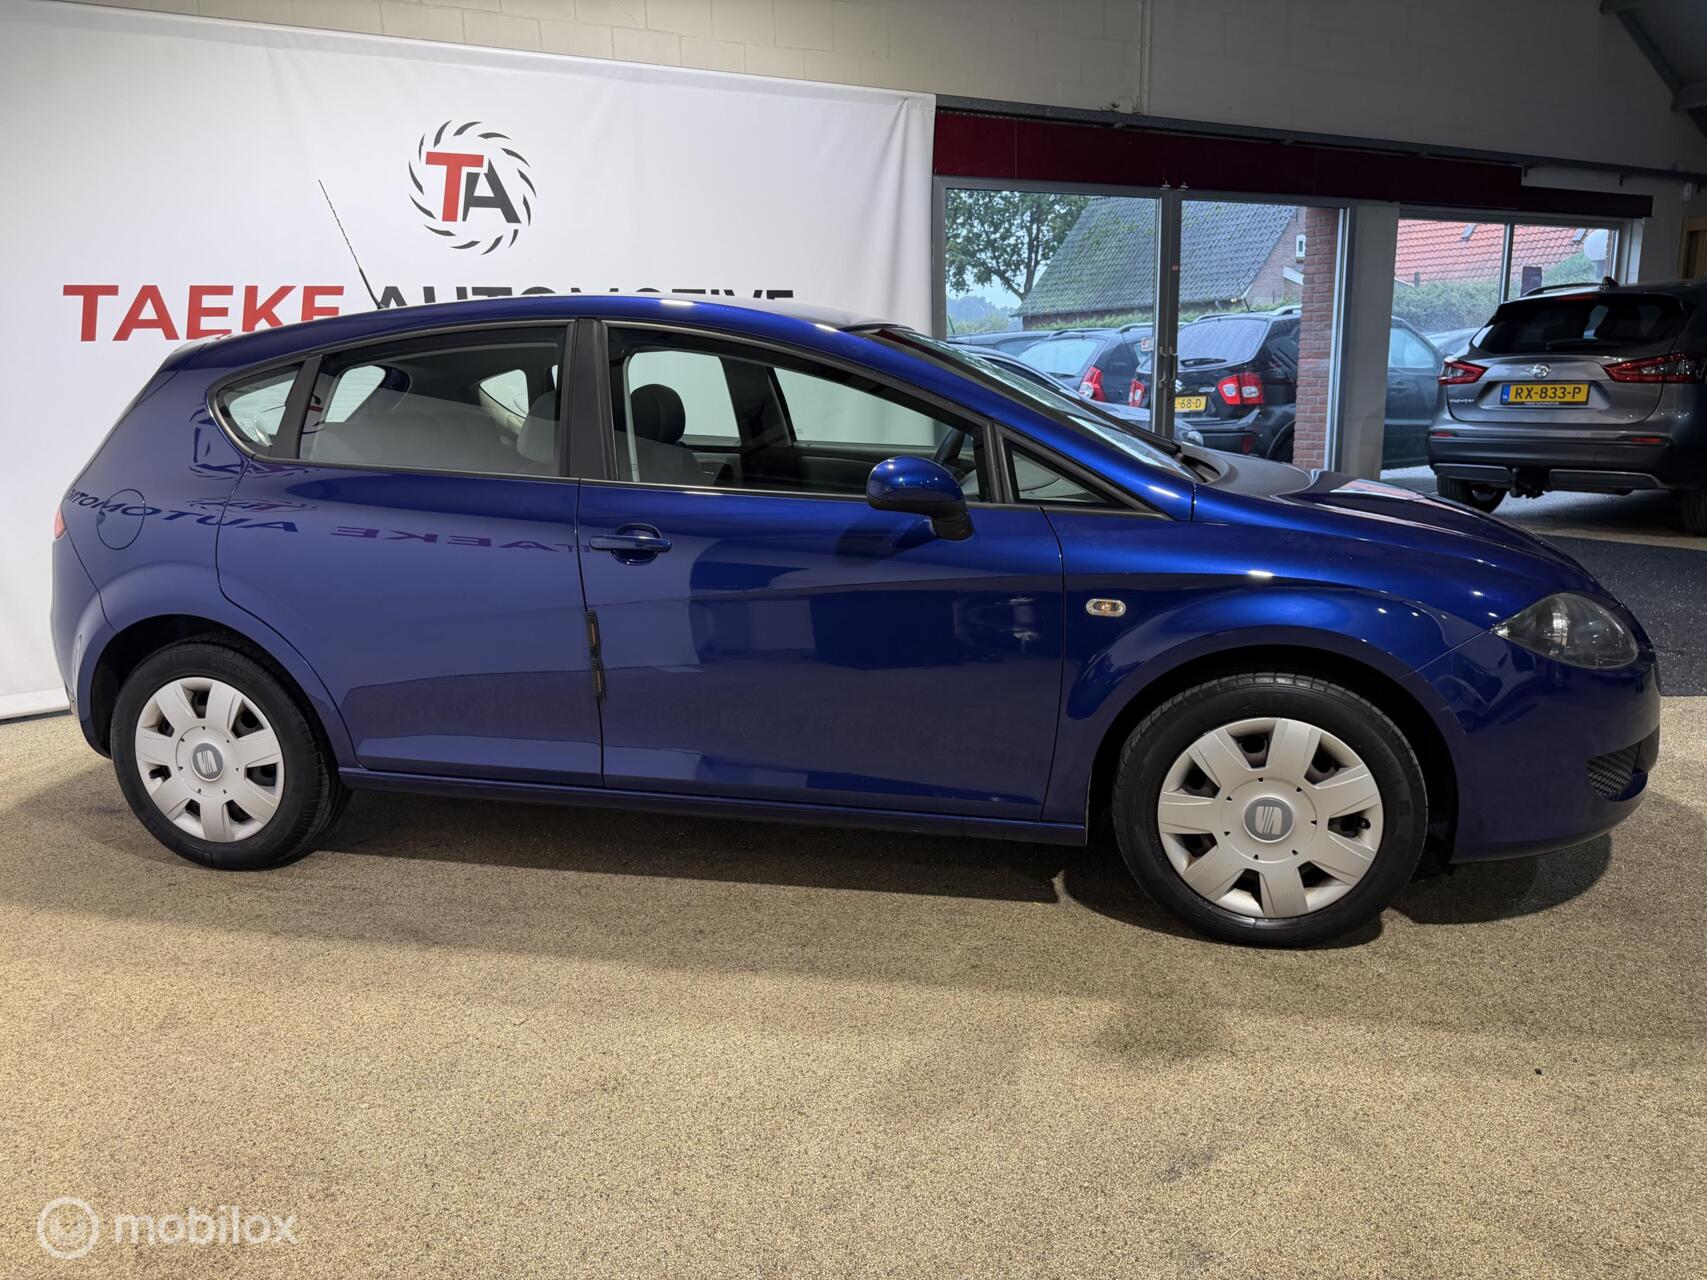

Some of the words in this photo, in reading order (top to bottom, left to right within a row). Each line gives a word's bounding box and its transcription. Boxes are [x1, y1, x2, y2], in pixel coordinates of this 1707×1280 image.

[425, 151, 522, 224] TA
[62, 284, 345, 342] TAEKE
[1175, 398, 1202, 409] -68-D
[1514, 386, 1582, 400] RX-833-P
